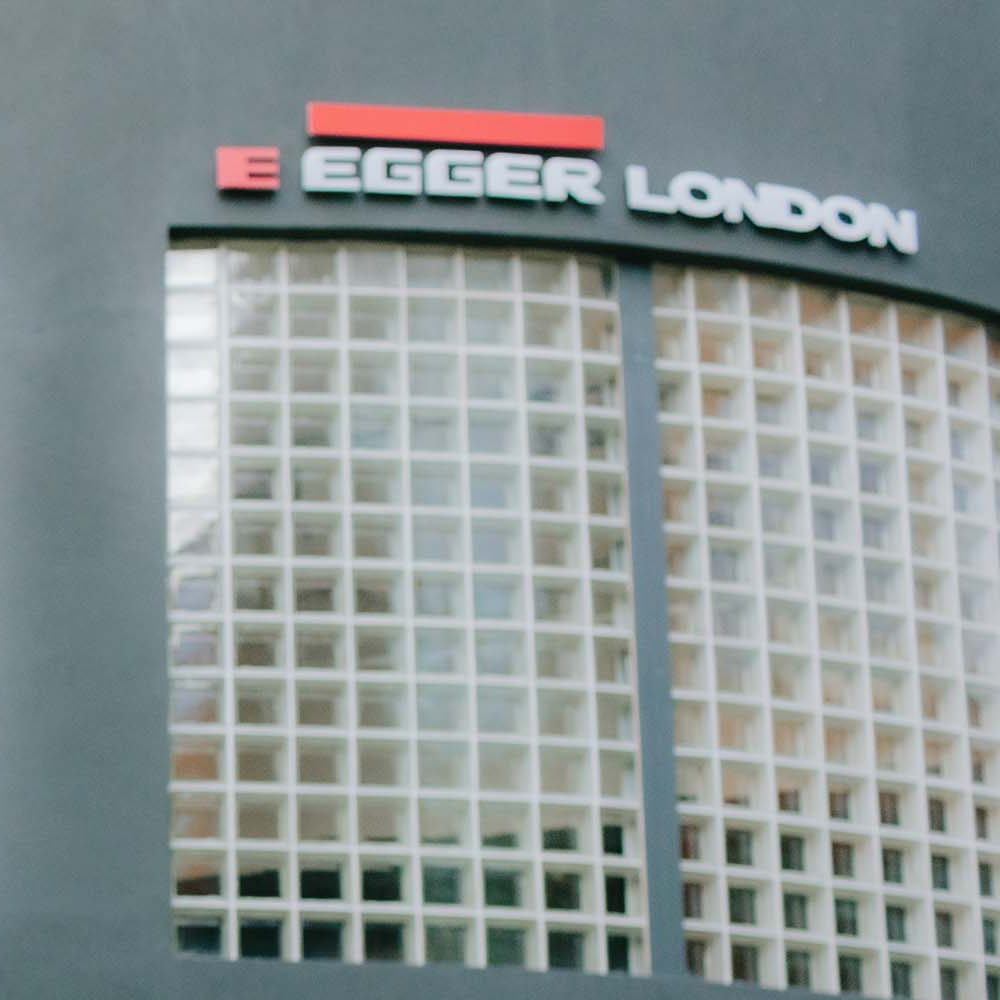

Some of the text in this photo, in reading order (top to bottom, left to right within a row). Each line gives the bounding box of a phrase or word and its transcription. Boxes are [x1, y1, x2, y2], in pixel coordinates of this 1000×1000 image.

[216, 146, 919, 256] E EGGER LONDON
